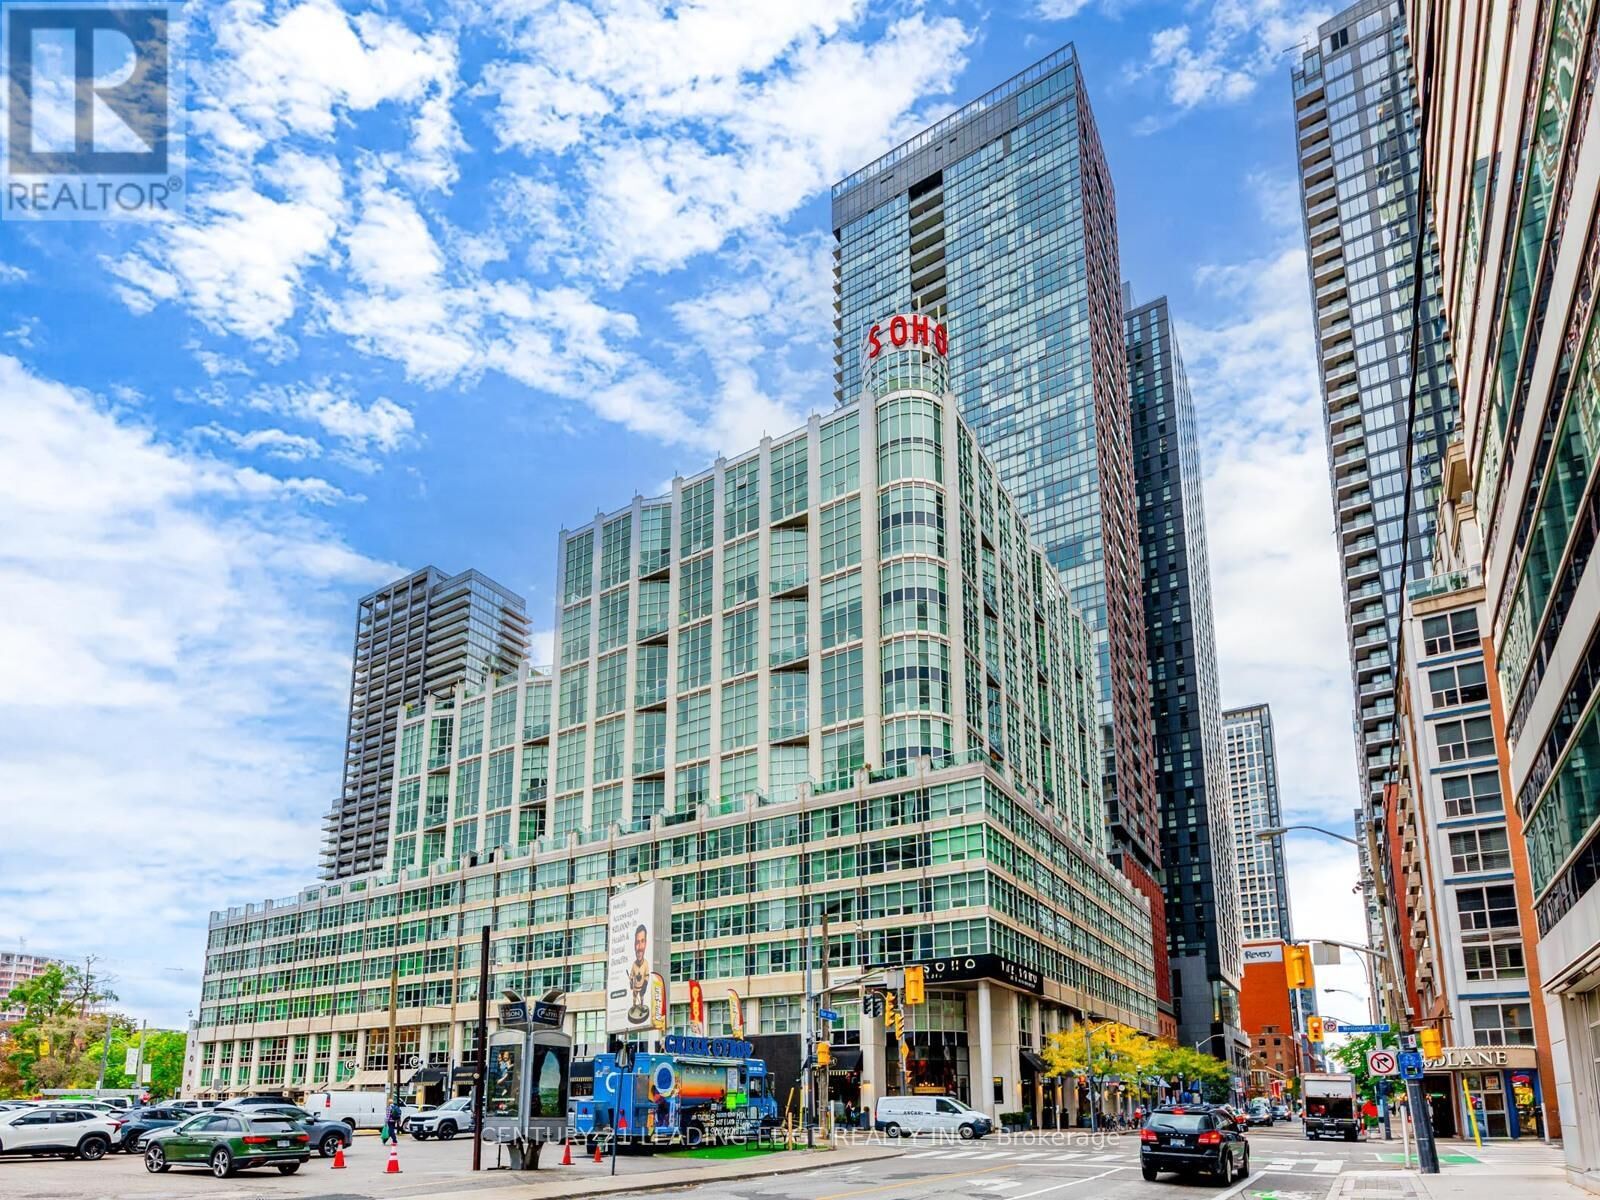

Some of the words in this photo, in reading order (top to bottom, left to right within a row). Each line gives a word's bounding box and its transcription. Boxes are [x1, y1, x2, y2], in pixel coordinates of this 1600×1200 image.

[869, 315, 947, 358] SOHO
[1244, 950, 1273, 959] Revery
[664, 1034, 712, 1056] GREEK
[712, 1038, 755, 1059] GYROS
